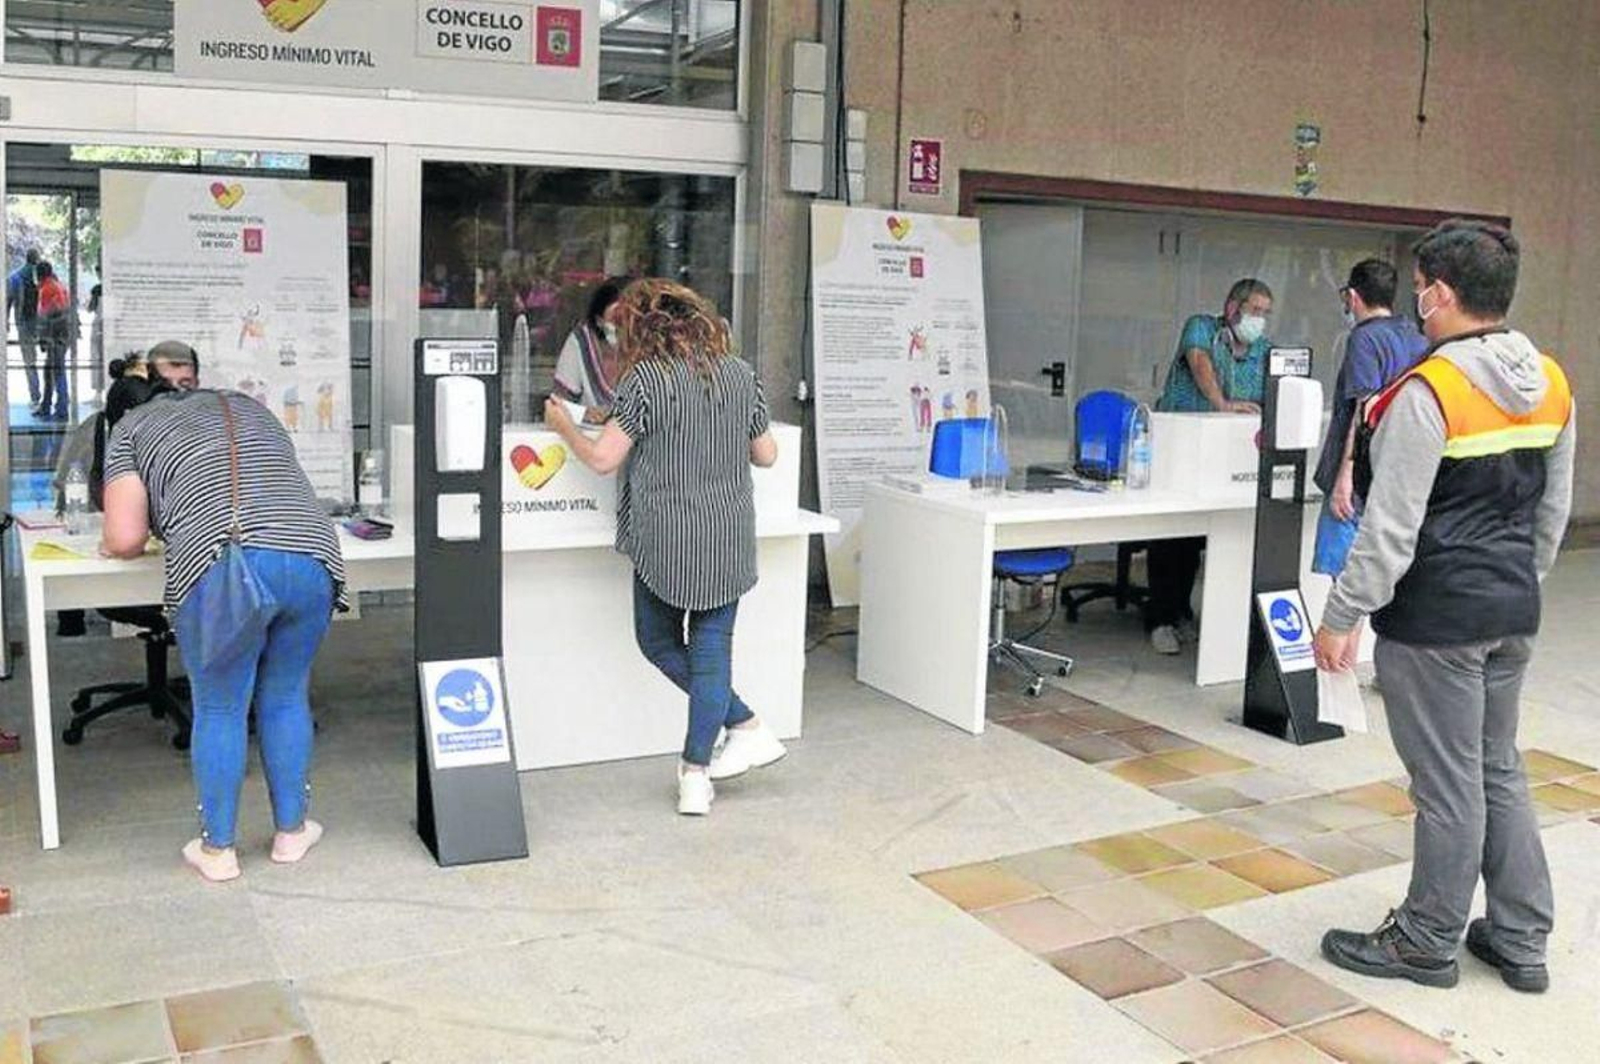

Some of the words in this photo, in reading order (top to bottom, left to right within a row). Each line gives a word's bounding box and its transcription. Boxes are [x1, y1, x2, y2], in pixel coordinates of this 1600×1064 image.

[426, 8, 523, 31] CONCELLO
[437, 31, 462, 49] DE
[465, 34, 512, 52] VIGO
[200, 41, 269, 61] INGRESO
[272, 42, 331, 64] MÍNIMO
[335, 50, 376, 67] VITAL
[569, 498, 599, 512] VITAL
